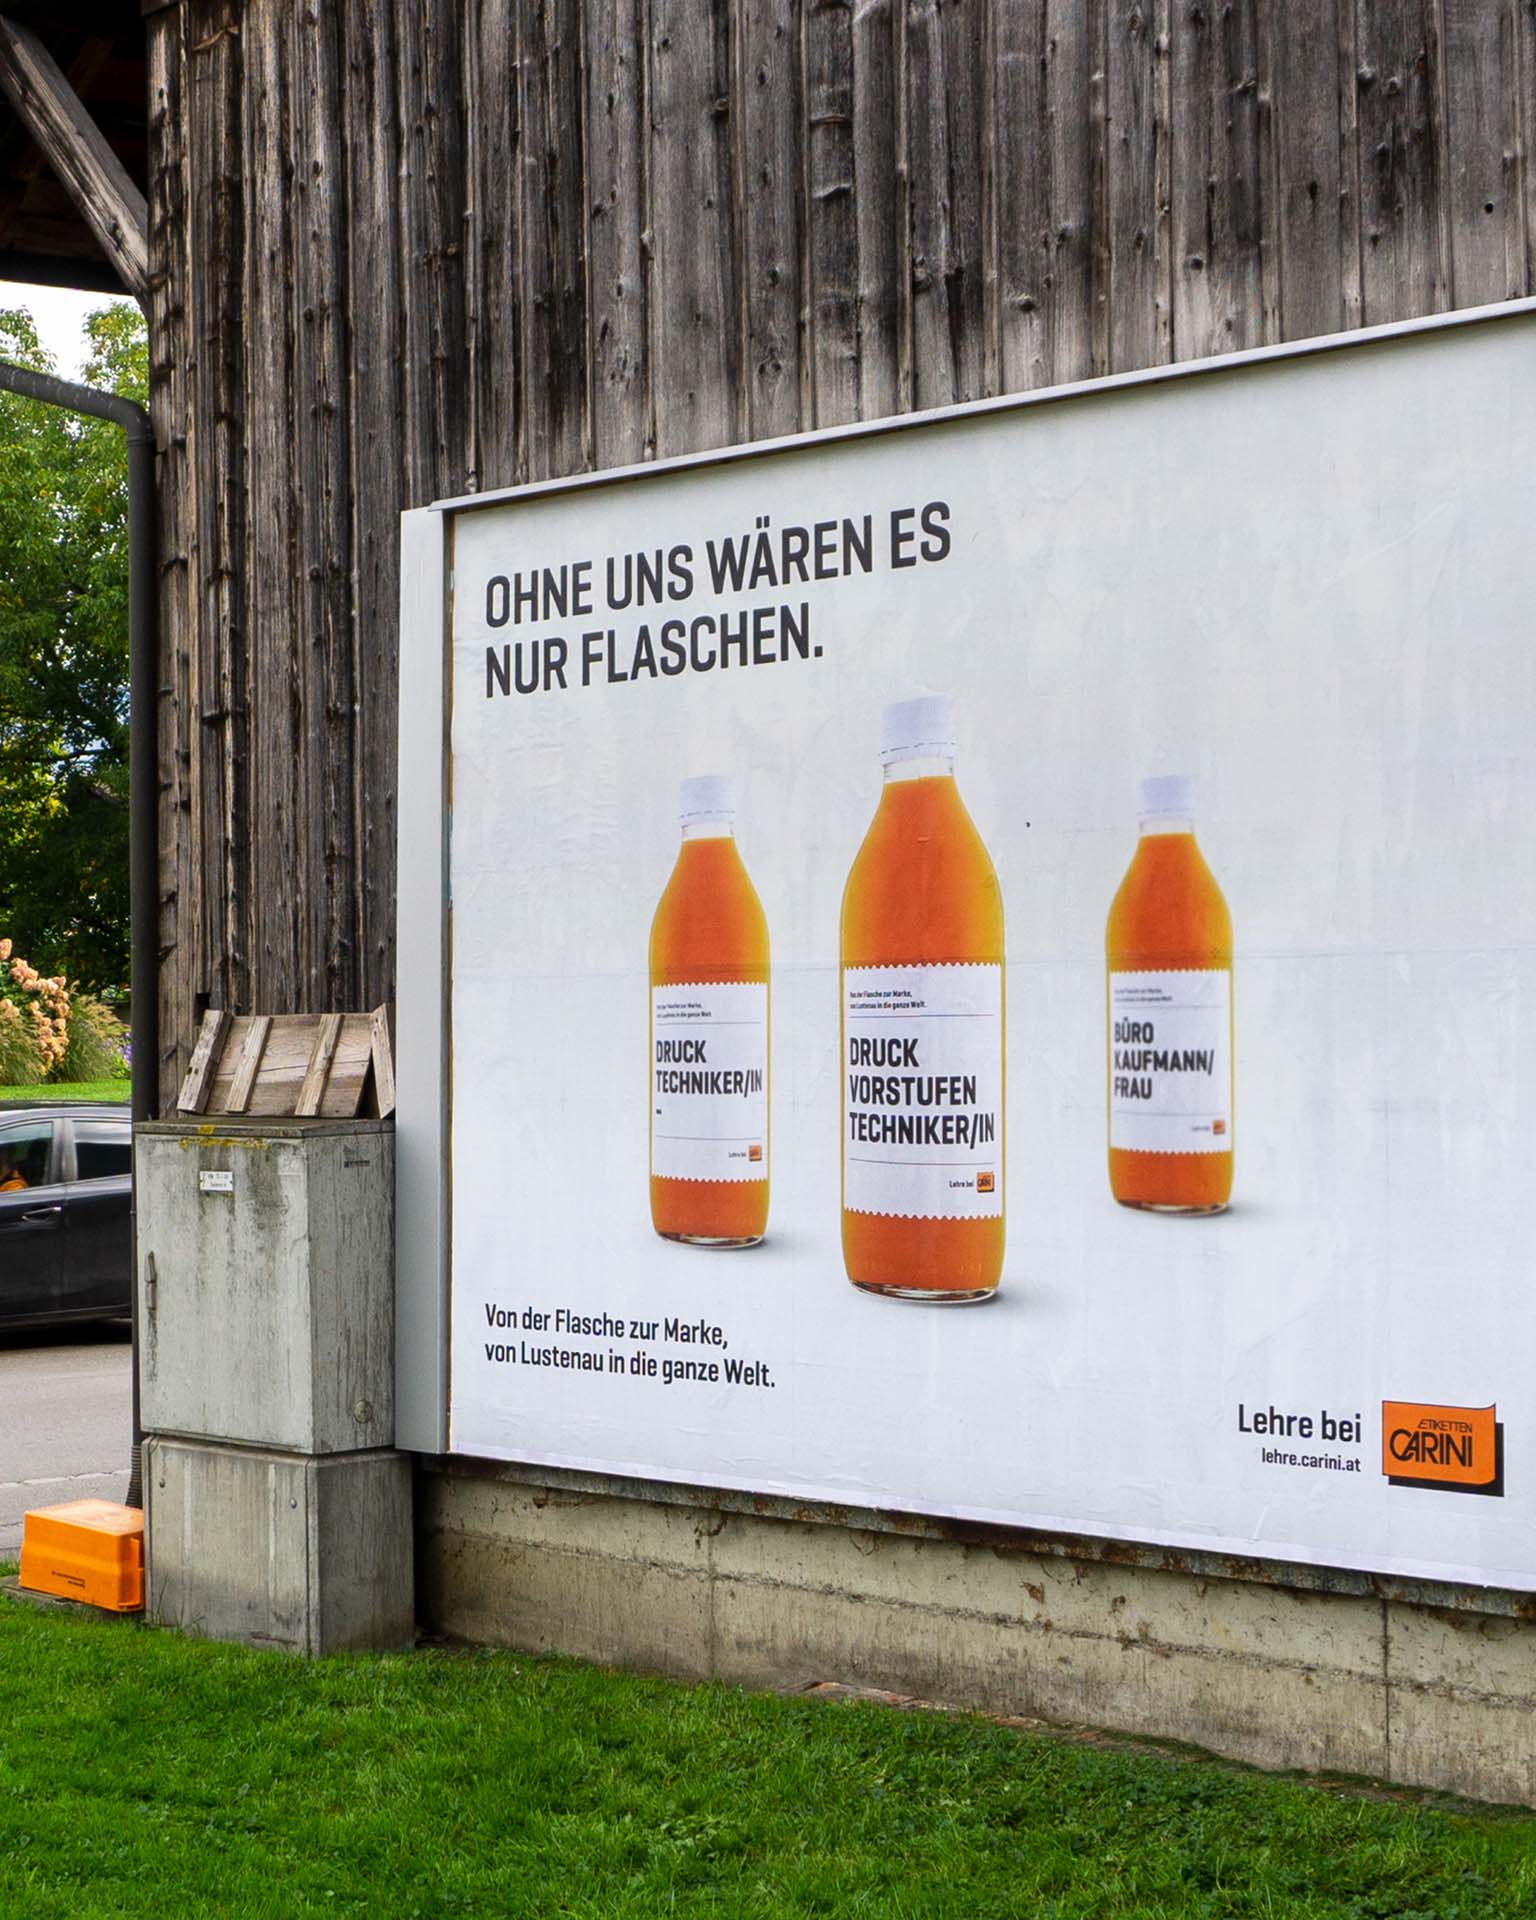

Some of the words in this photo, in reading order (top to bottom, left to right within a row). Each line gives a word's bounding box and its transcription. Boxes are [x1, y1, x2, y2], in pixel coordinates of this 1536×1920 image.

[486, 561, 593, 628] OHNE
[606, 544, 694, 610] UNS
[706, 515, 873, 594] WÄREN
[890, 501, 951, 569] ES
[486, 637, 568, 698] NUR
[582, 602, 824, 686] FLASCHEN.
[1114, 1017, 1154, 1044] BÜRO
[656, 1040, 706, 1064] DRUCK
[849, 1037, 919, 1067] DRUCK
[1114, 1049, 1214, 1076] KAUFMANN/
[656, 1069, 762, 1098] TECHNIKER/IN
[849, 1075, 976, 1106] VORSTUFEN
[1114, 1077, 1152, 1100] FRAU
[849, 1111, 995, 1149] TECHNIKER/IN
[485, 1303, 517, 1329] Von
[522, 1306, 551, 1331] der
[555, 1309, 625, 1338] Flasche
[629, 1320, 659, 1341] zur
[664, 1317, 728, 1350] Marke,
[485, 1343, 516, 1364] von
[521, 1341, 602, 1372] Lustenau
[608, 1348, 625, 1374] in
[630, 1351, 657, 1377] die
[663, 1358, 719, 1384] ganze
[724, 1358, 776, 1388] Welt.
[1238, 1403, 1313, 1438] Lehre
[1321, 1410, 1361, 1443] bei
[1417, 1418, 1473, 1434] ETIKETTEN
[1261, 1447, 1361, 1473] lehre.carini.at
[1389, 1428, 1473, 1468] CARINI
